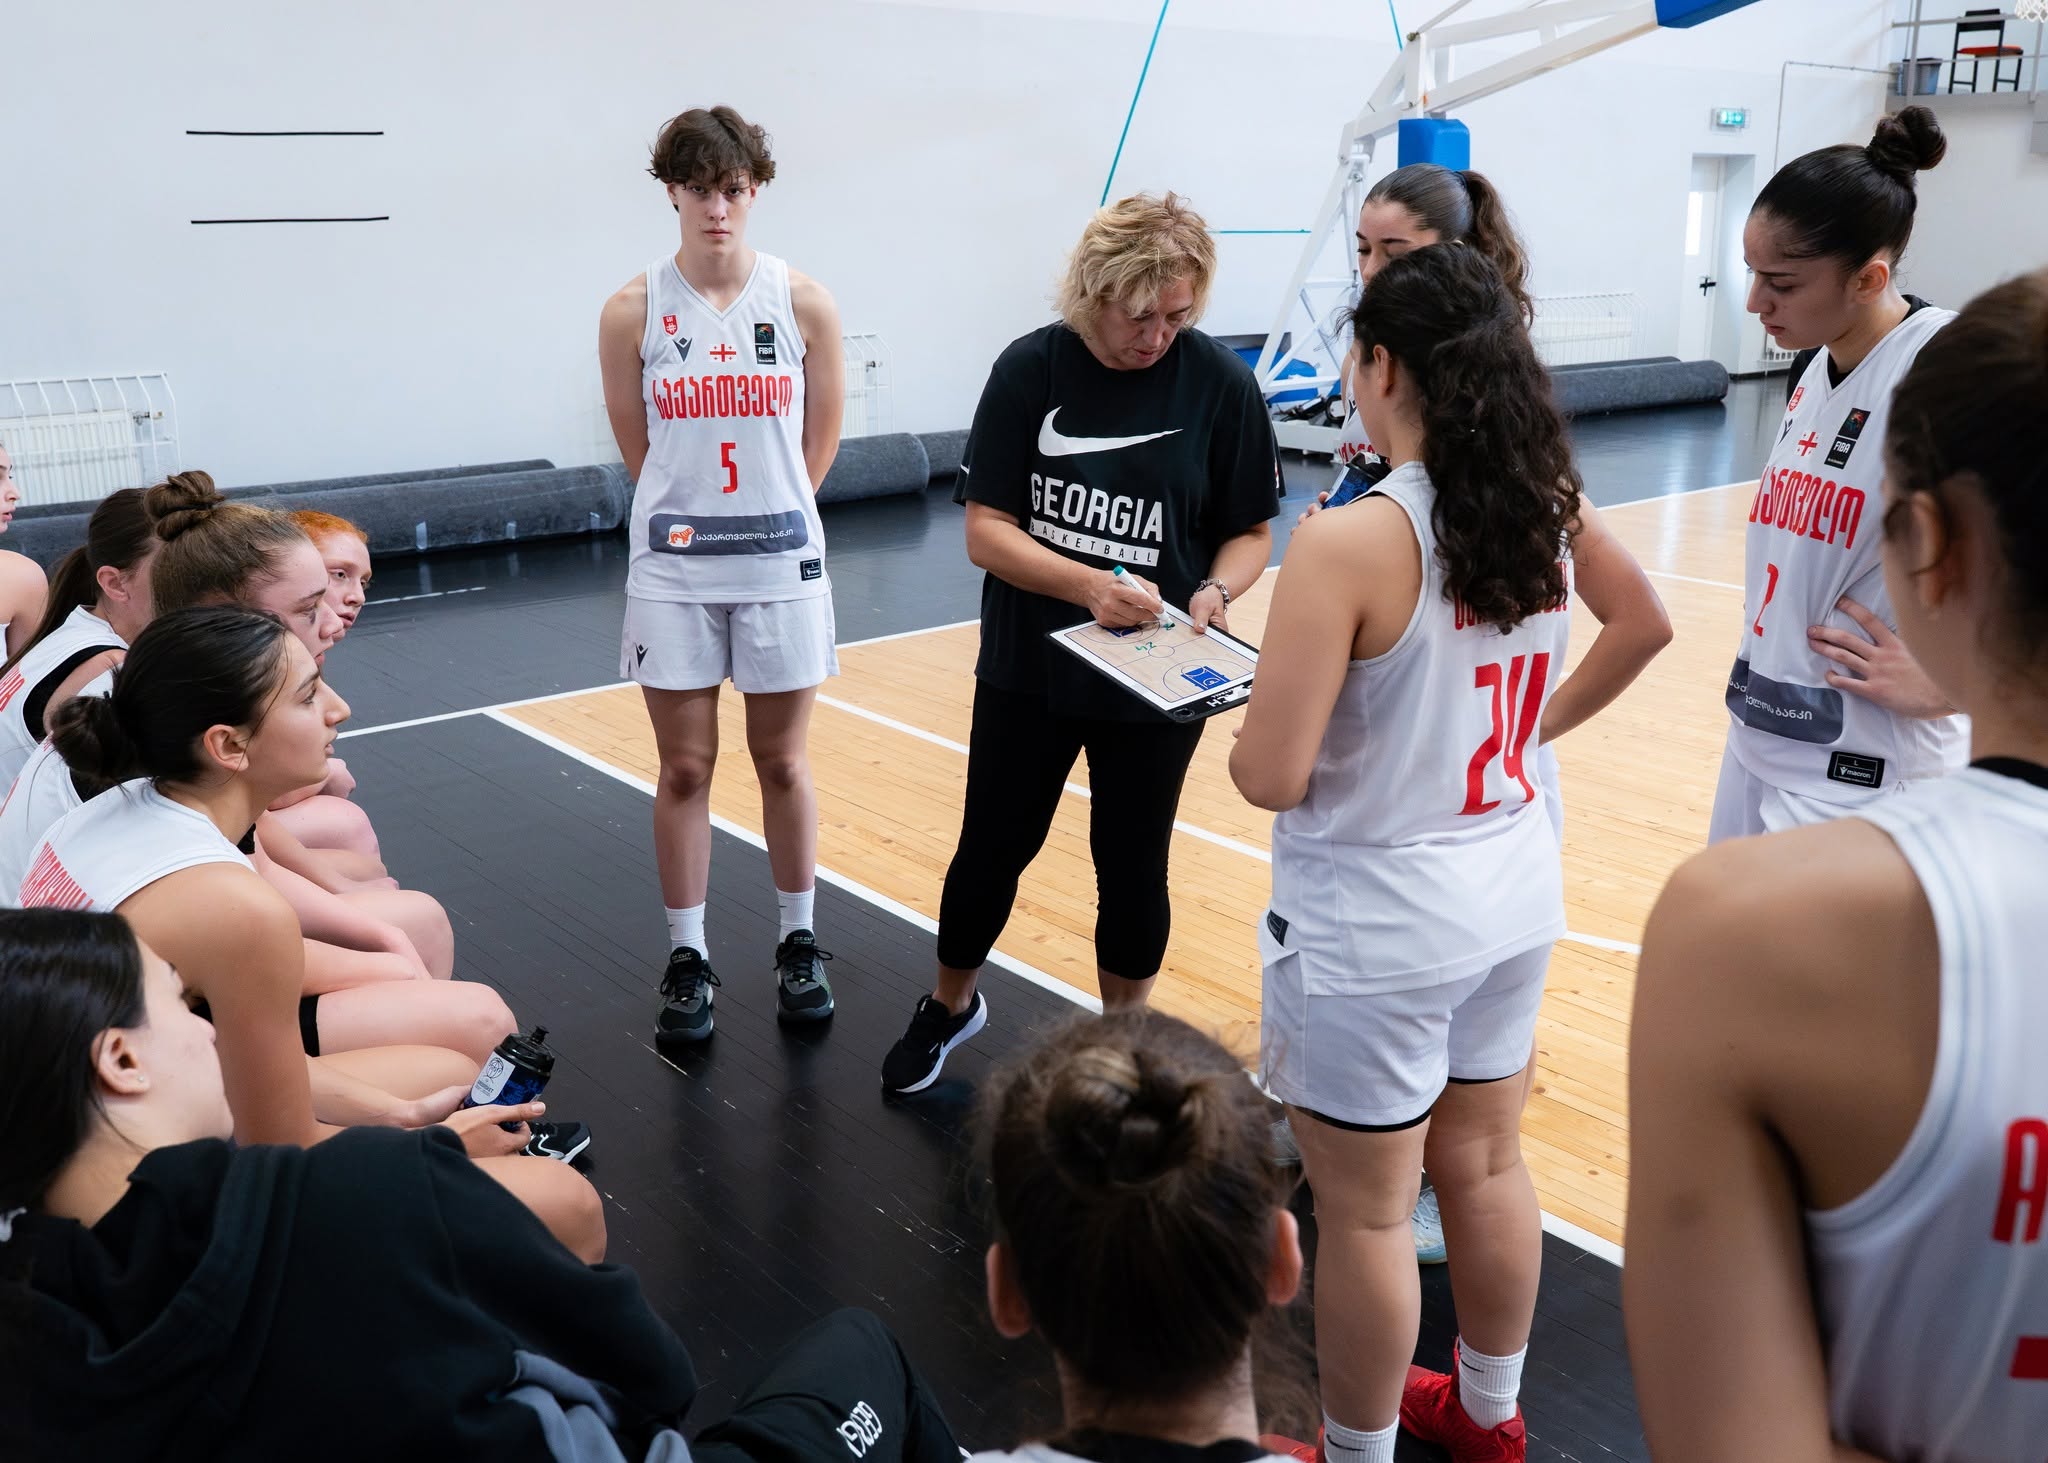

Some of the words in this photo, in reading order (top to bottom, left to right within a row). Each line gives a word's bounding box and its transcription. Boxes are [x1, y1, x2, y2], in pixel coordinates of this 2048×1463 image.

[758, 347, 773, 355] FIBA
[652, 375, 793, 420] საქართველო
[720, 442, 738, 493] 5
[1833, 440, 1851, 454] FIBA
[1030, 472, 1163, 542] GEORGIA
[1030, 520, 1153, 563] BASKETBALL
[1753, 562, 1779, 637] 2
[1455, 652, 1550, 816] 24
[1846, 770, 1871, 779] macron
